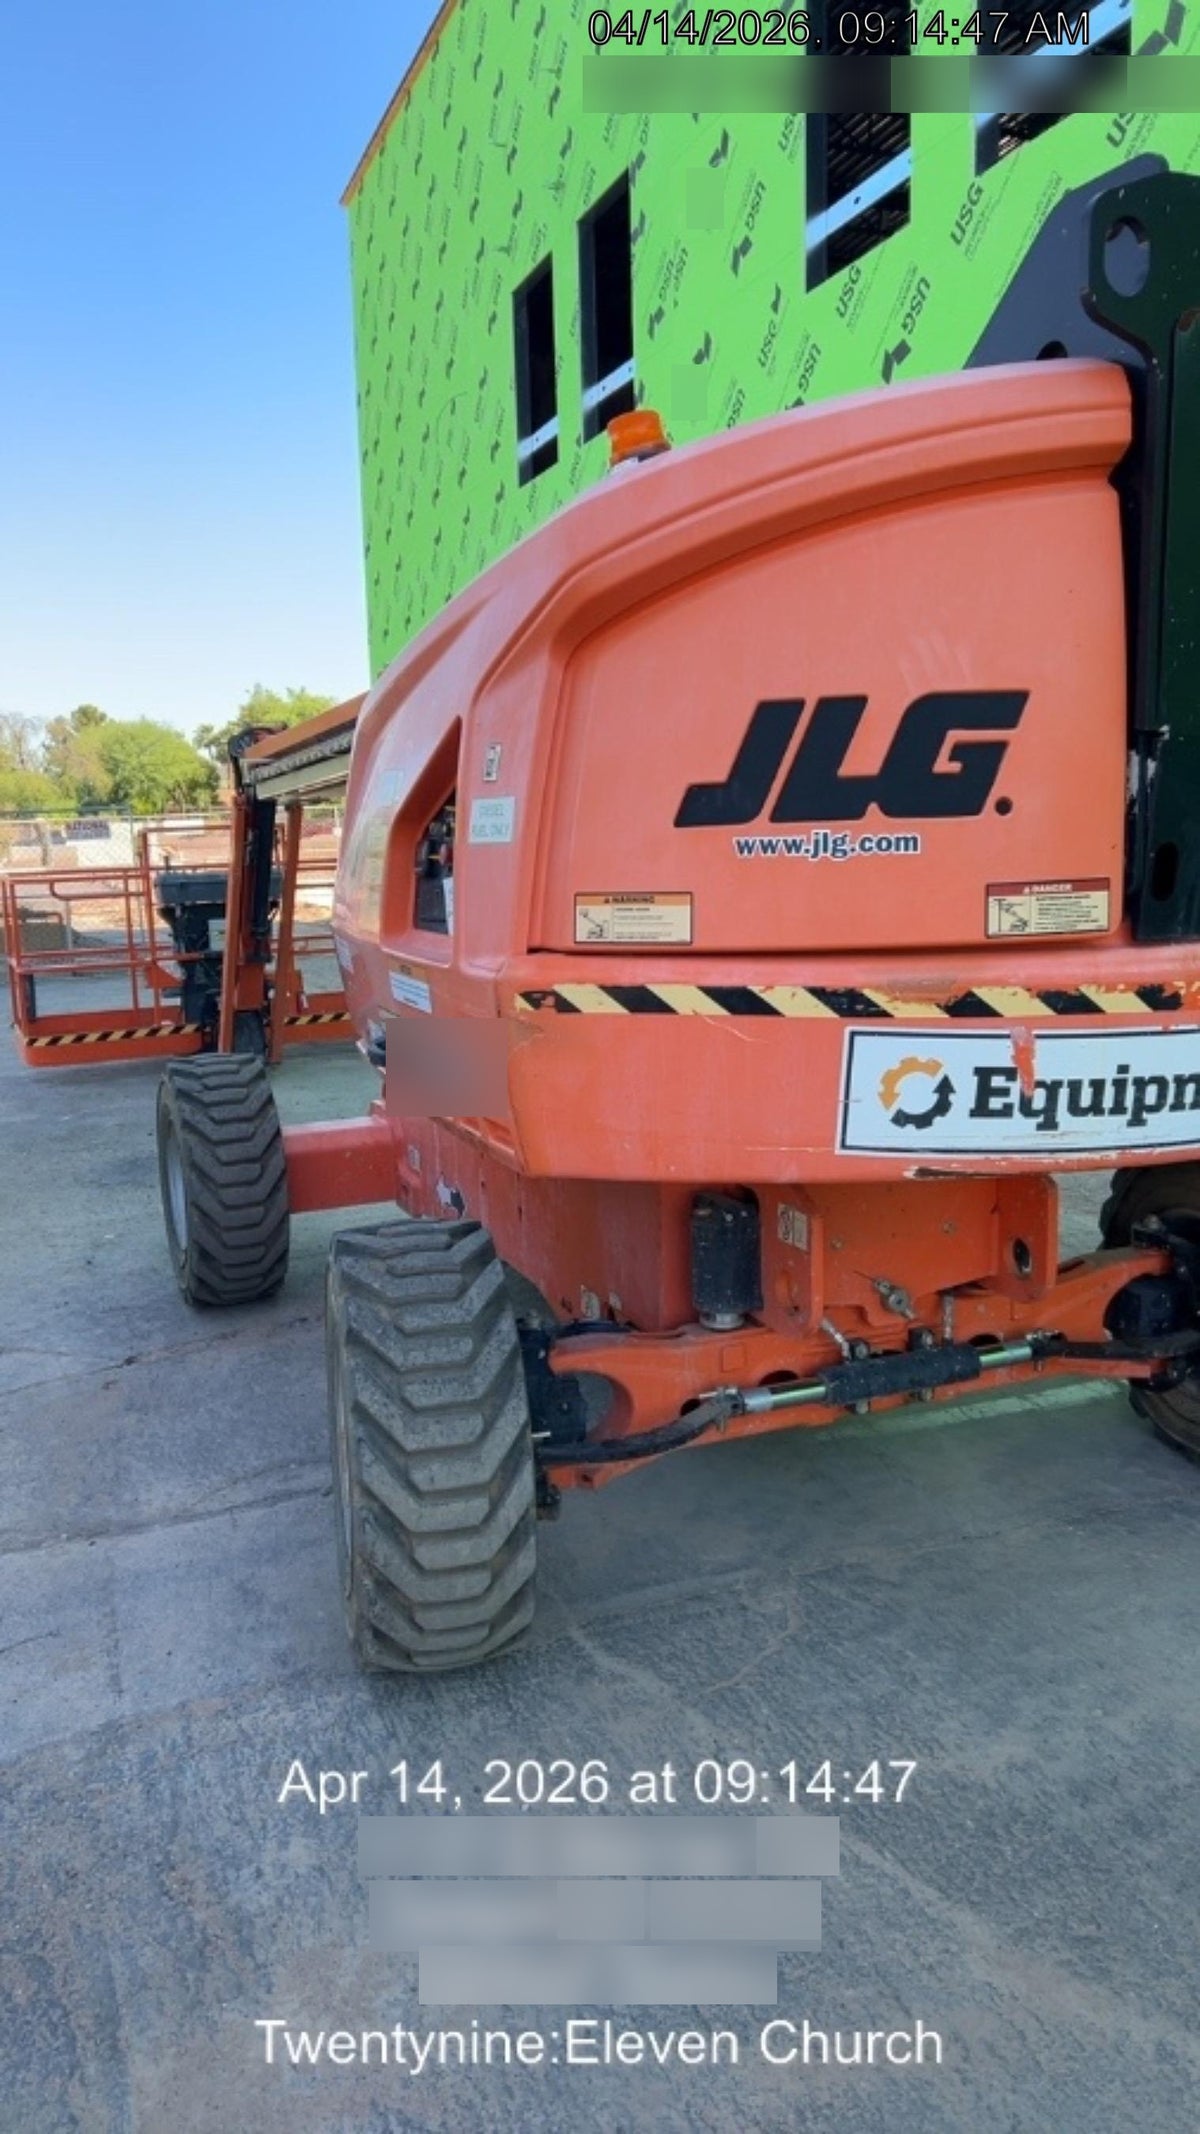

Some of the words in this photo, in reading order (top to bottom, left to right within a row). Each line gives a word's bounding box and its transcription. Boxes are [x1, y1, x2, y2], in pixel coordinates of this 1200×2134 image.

[950, 182, 984, 246] USG
[835, 264, 862, 318] USG
[901, 276, 931, 336] USG
[758, 319, 777, 368] USG
[799, 342, 821, 394] USG
[735, 831, 919, 860] www.jlg.com
